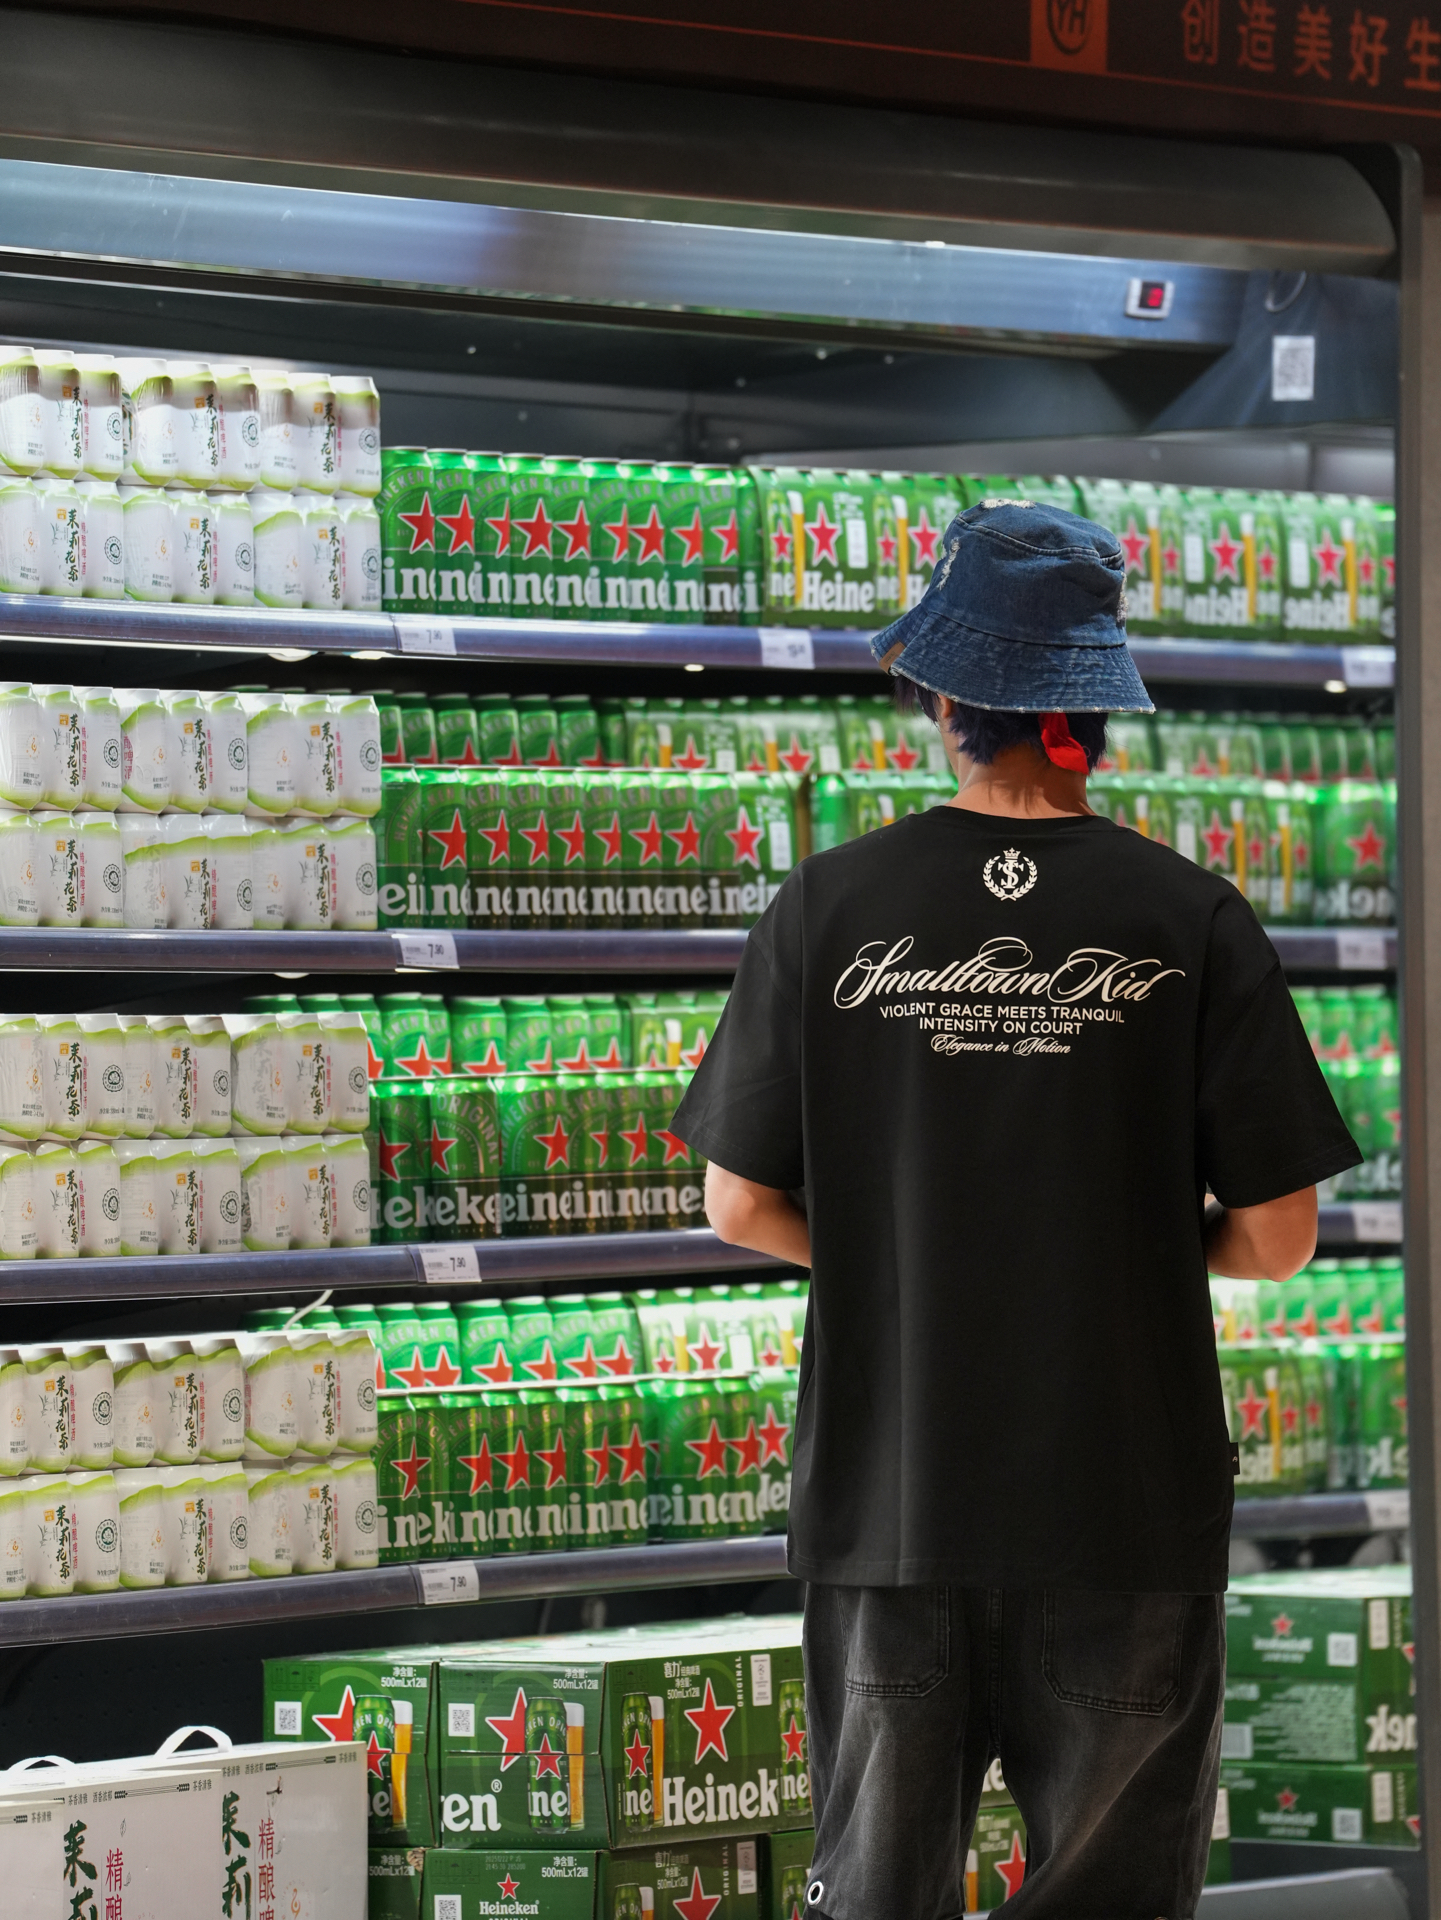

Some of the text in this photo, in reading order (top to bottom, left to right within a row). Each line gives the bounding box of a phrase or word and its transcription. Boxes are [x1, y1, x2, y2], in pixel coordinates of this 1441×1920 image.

[1181, 0, 1441, 91] 创造美好生
[67, 713, 80, 787] 茉莉花茶
[64, 839, 78, 914] 茉莉花茶
[834, 936, 1186, 1009] Smalltown Kid
[879, 1002, 1125, 1024] VIOLENT GRACE MEETS TRANQUIL
[919, 1016, 1083, 1036] INTENSITY ON COURT
[930, 1034, 1071, 1057] Elegance in Motion
[66, 1042, 82, 1117] 茉莉花茶
[437, 1093, 499, 1165] ORIGINAL
[66, 1170, 78, 1245] 茉莉花茶
[450, 1256, 466, 1272] 7.90
[56, 1375, 69, 1450] 茉莉花茶
[184, 1373, 198, 1449] 茉莉花茶
[56, 1505, 70, 1579] 茉莉花茶
[450, 1576, 467, 1592] 7.90
[735, 1656, 744, 1708] ORIGINAL
[663, 1769, 779, 1827] Heinek
[541, 1867, 589, 1878] 500mLx12罐
[553, 1856, 577, 1867] 净含量:
[479, 1901, 539, 1915] Heineken
